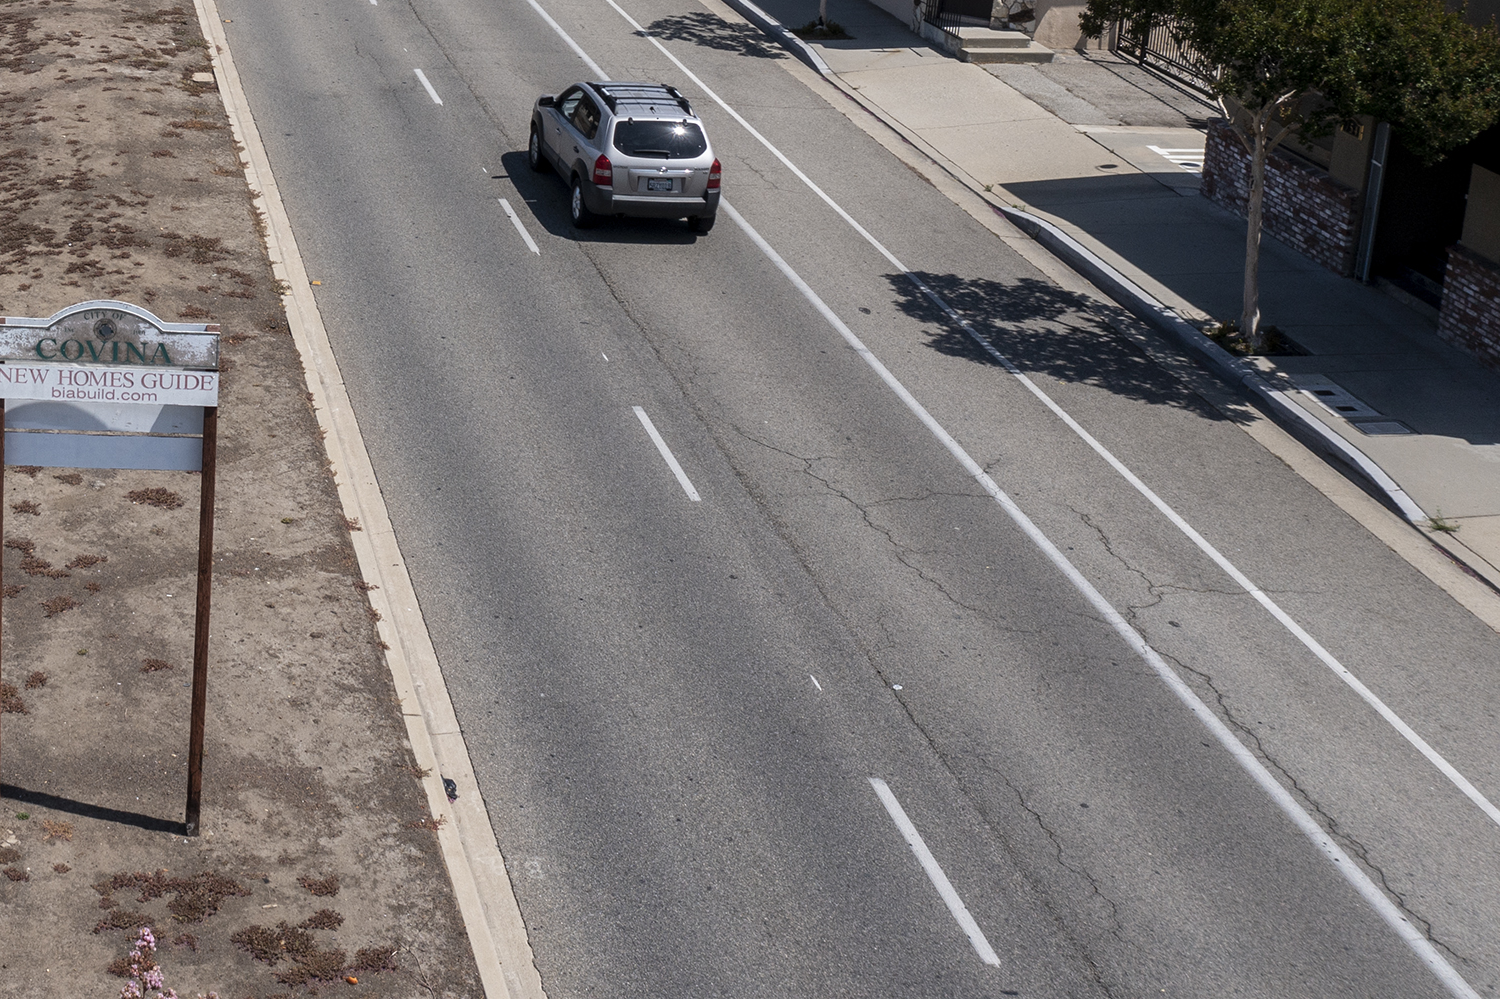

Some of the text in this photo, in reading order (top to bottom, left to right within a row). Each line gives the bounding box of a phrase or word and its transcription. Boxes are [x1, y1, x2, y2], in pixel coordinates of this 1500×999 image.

[83, 311, 127, 321] CITY OF
[35, 337, 173, 364] COVINA
[57, 369, 135, 389] HOMES
[141, 372, 215, 391] GUIDE
[51, 386, 158, 402] biabuild.com
